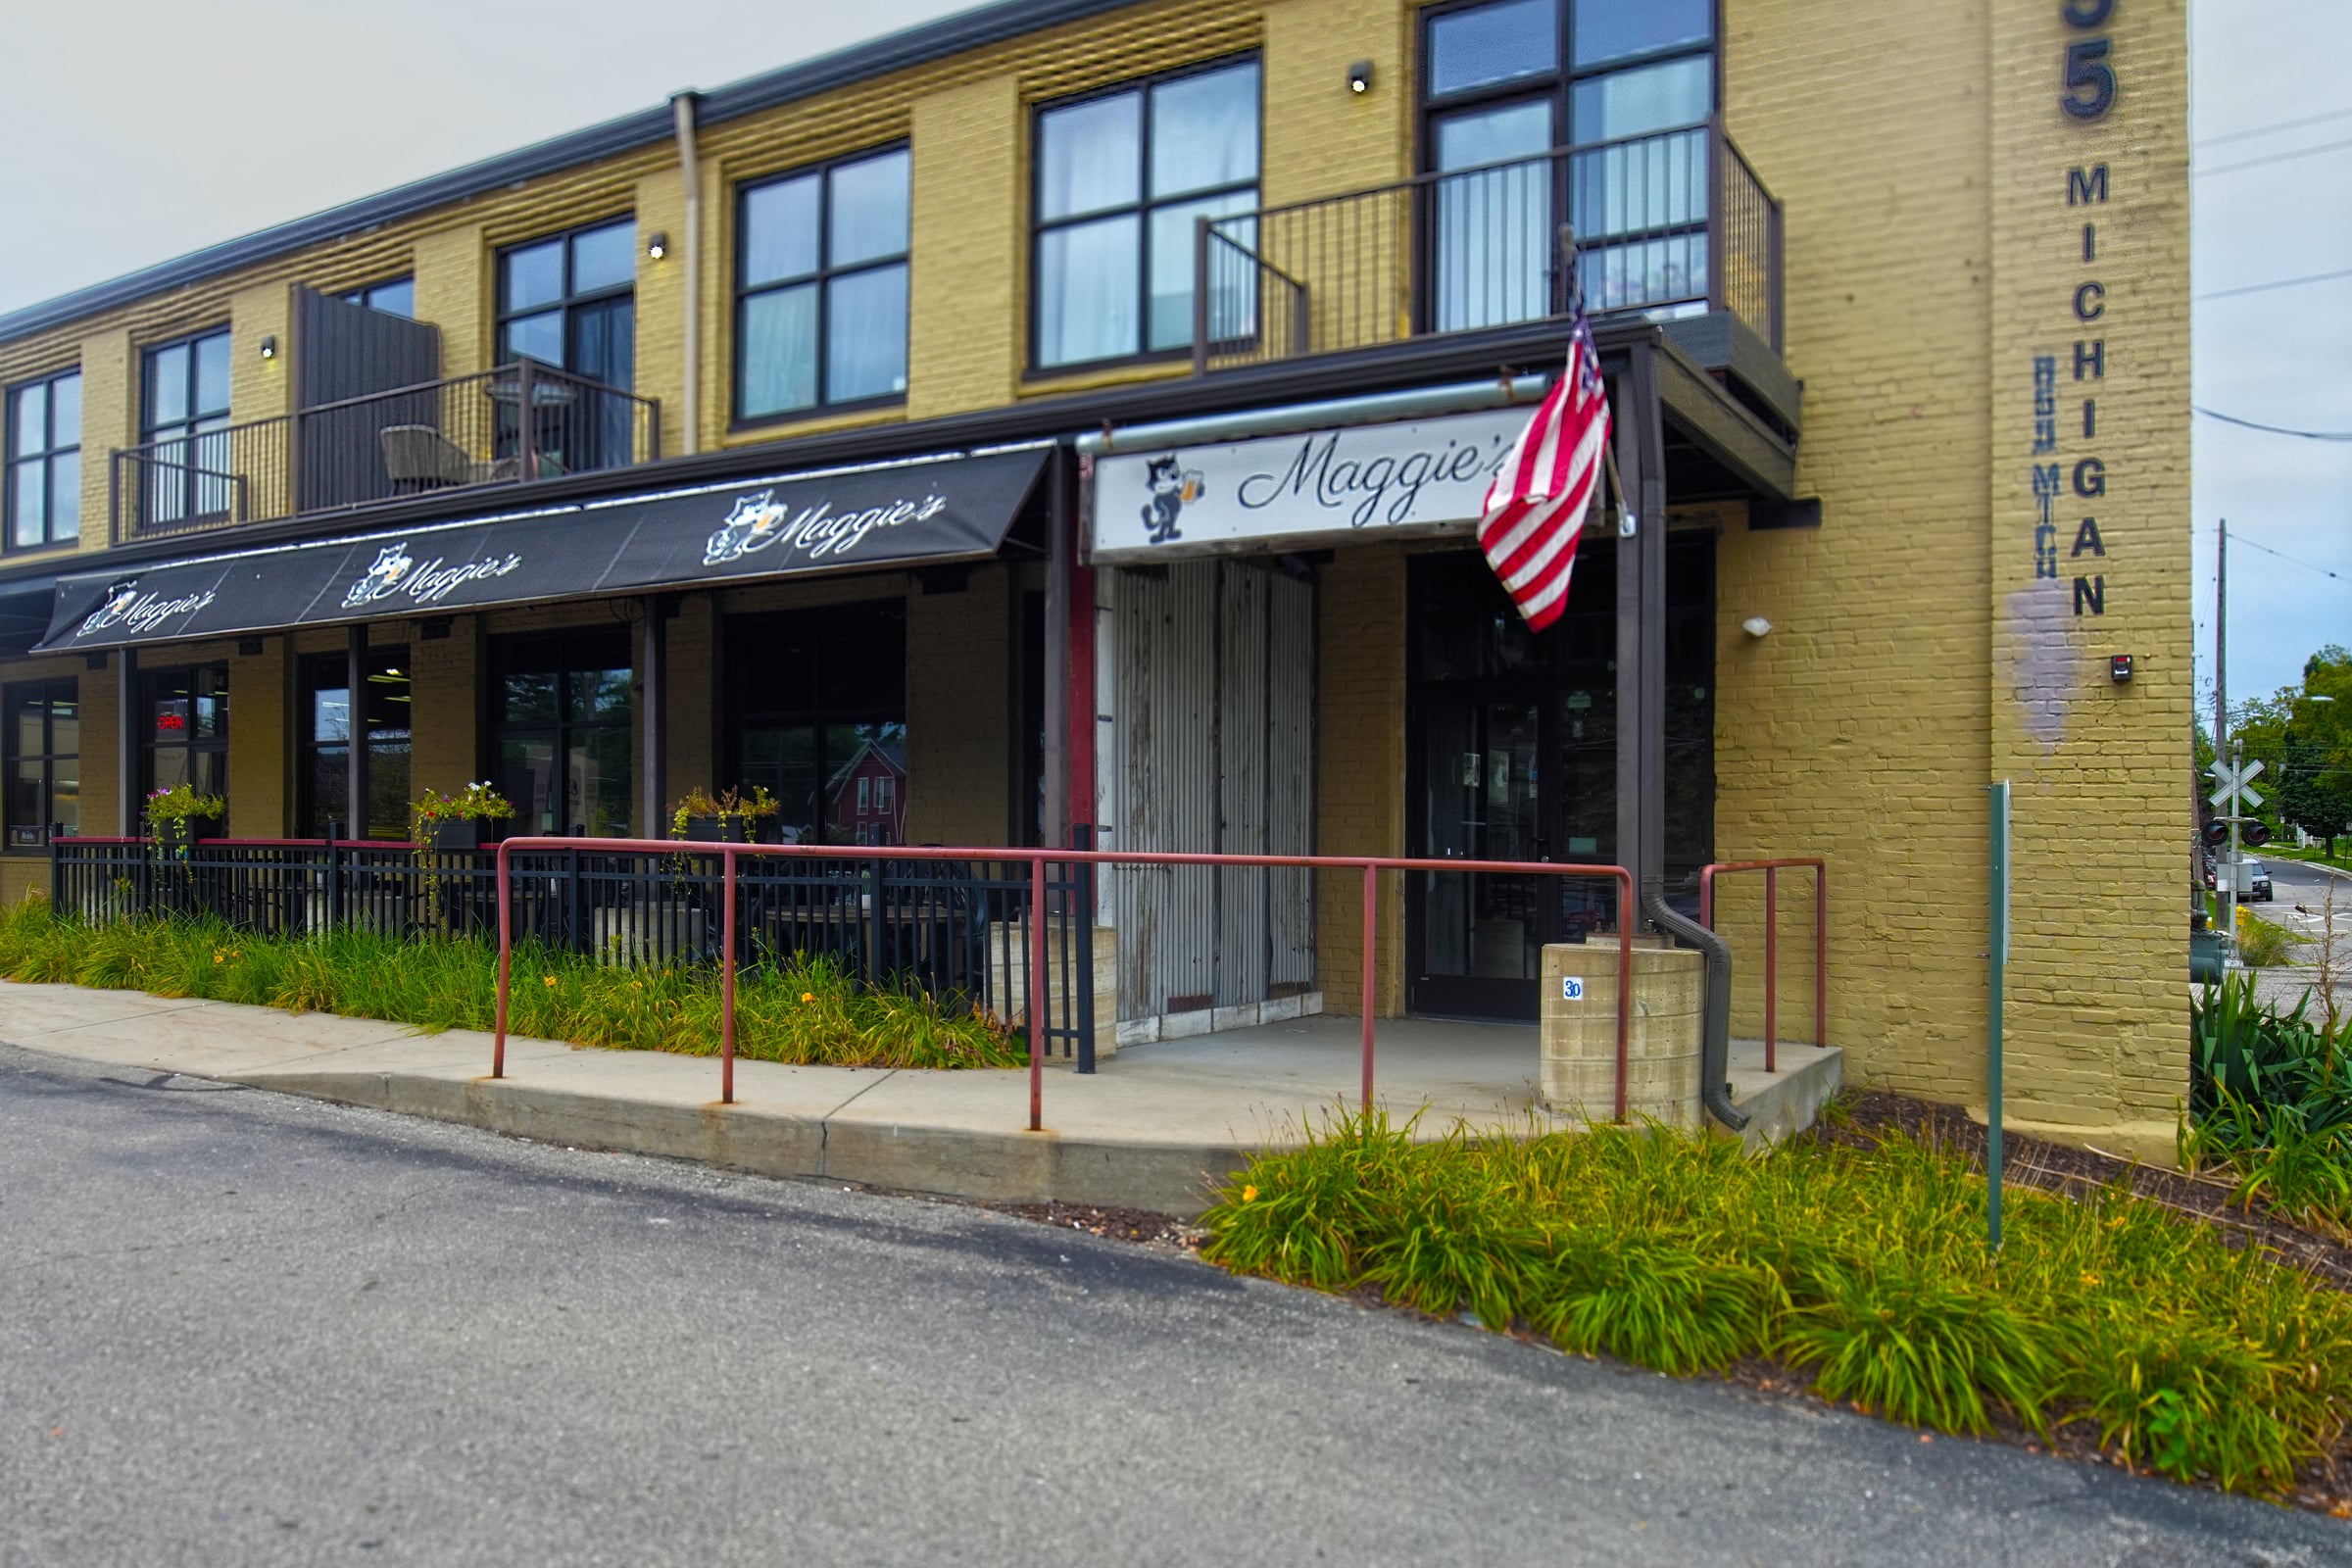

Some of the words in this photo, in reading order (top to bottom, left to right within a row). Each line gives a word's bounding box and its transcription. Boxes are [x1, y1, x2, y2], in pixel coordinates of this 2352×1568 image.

[2067, 163, 2109, 617] MICHIGAN
[742, 493, 947, 560] Maggie's
[372, 553, 522, 604] Maggie's
[100, 590, 217, 634] Maggie's
[158, 714, 184, 730] OPEN
